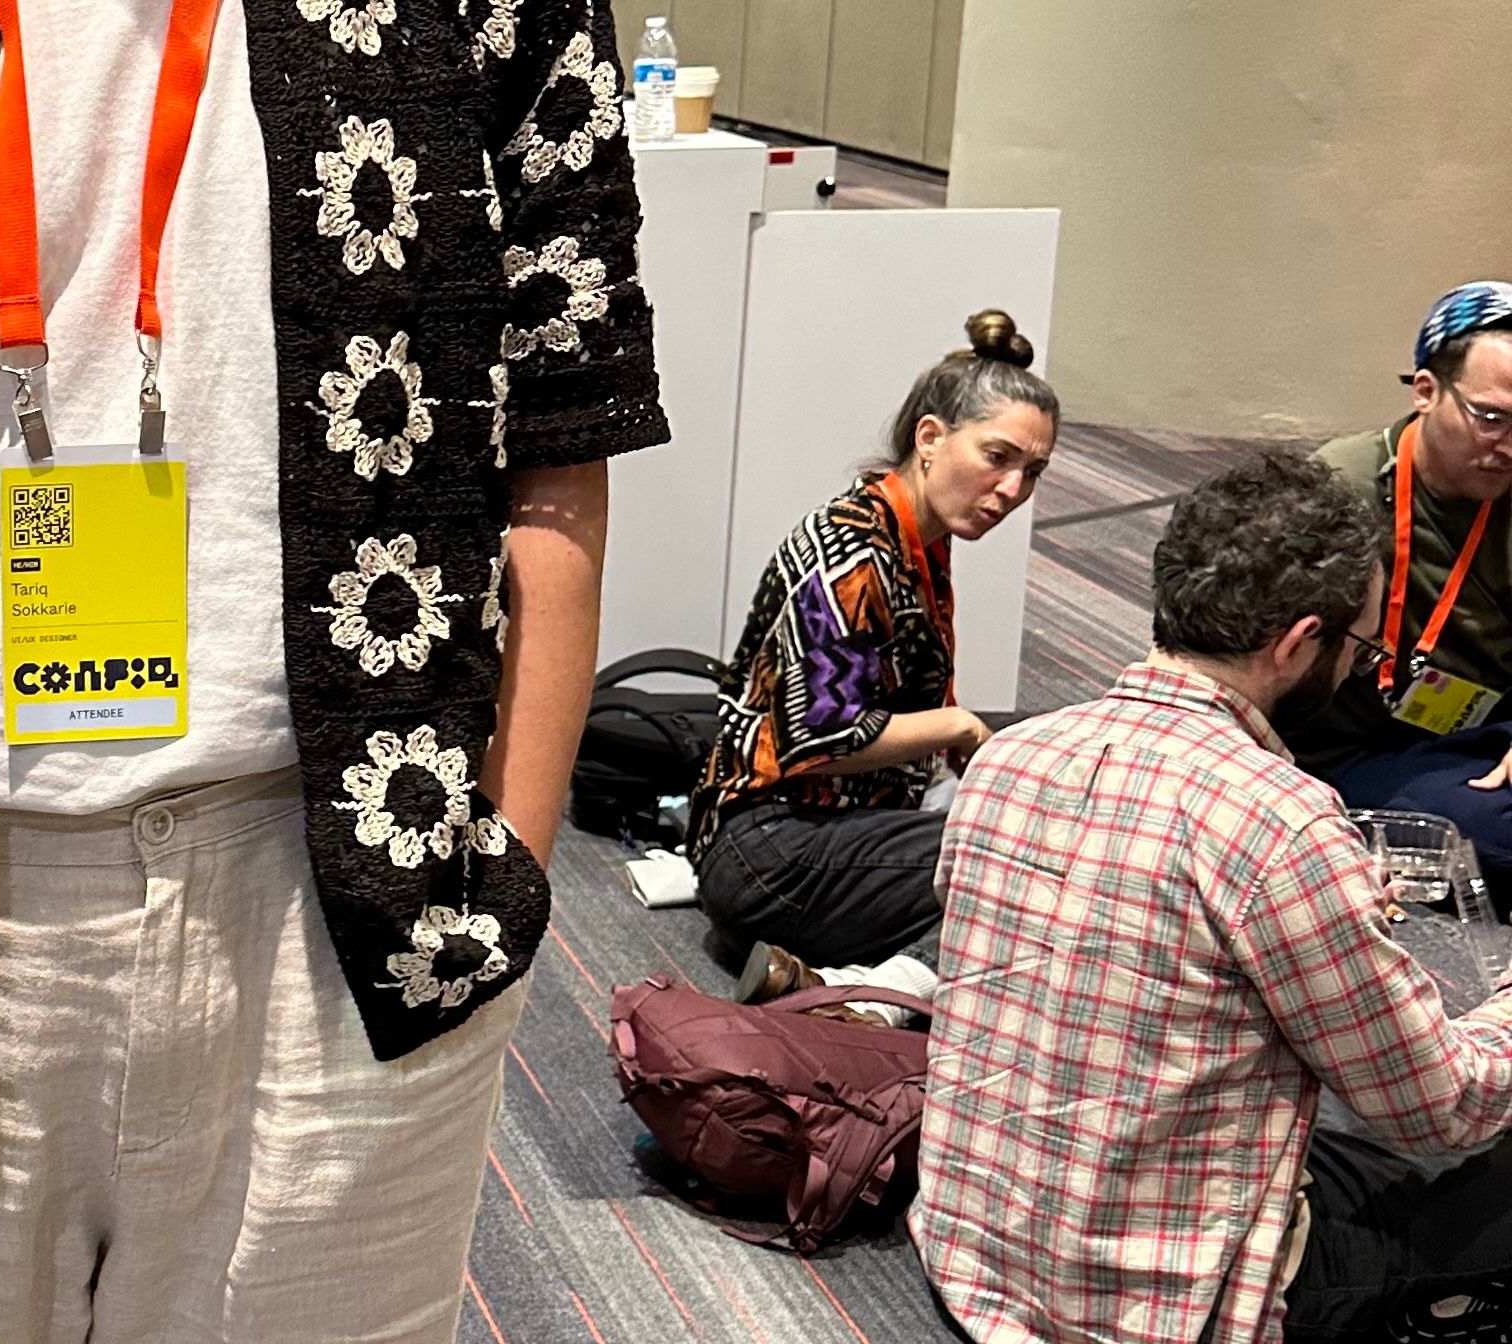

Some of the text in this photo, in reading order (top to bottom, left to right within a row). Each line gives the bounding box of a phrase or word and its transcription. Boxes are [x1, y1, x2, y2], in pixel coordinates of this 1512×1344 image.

[11, 583, 48, 597] Tariq
[11, 602, 77, 617] Sokkarie
[69, 707, 124, 721] ATTENDEE
